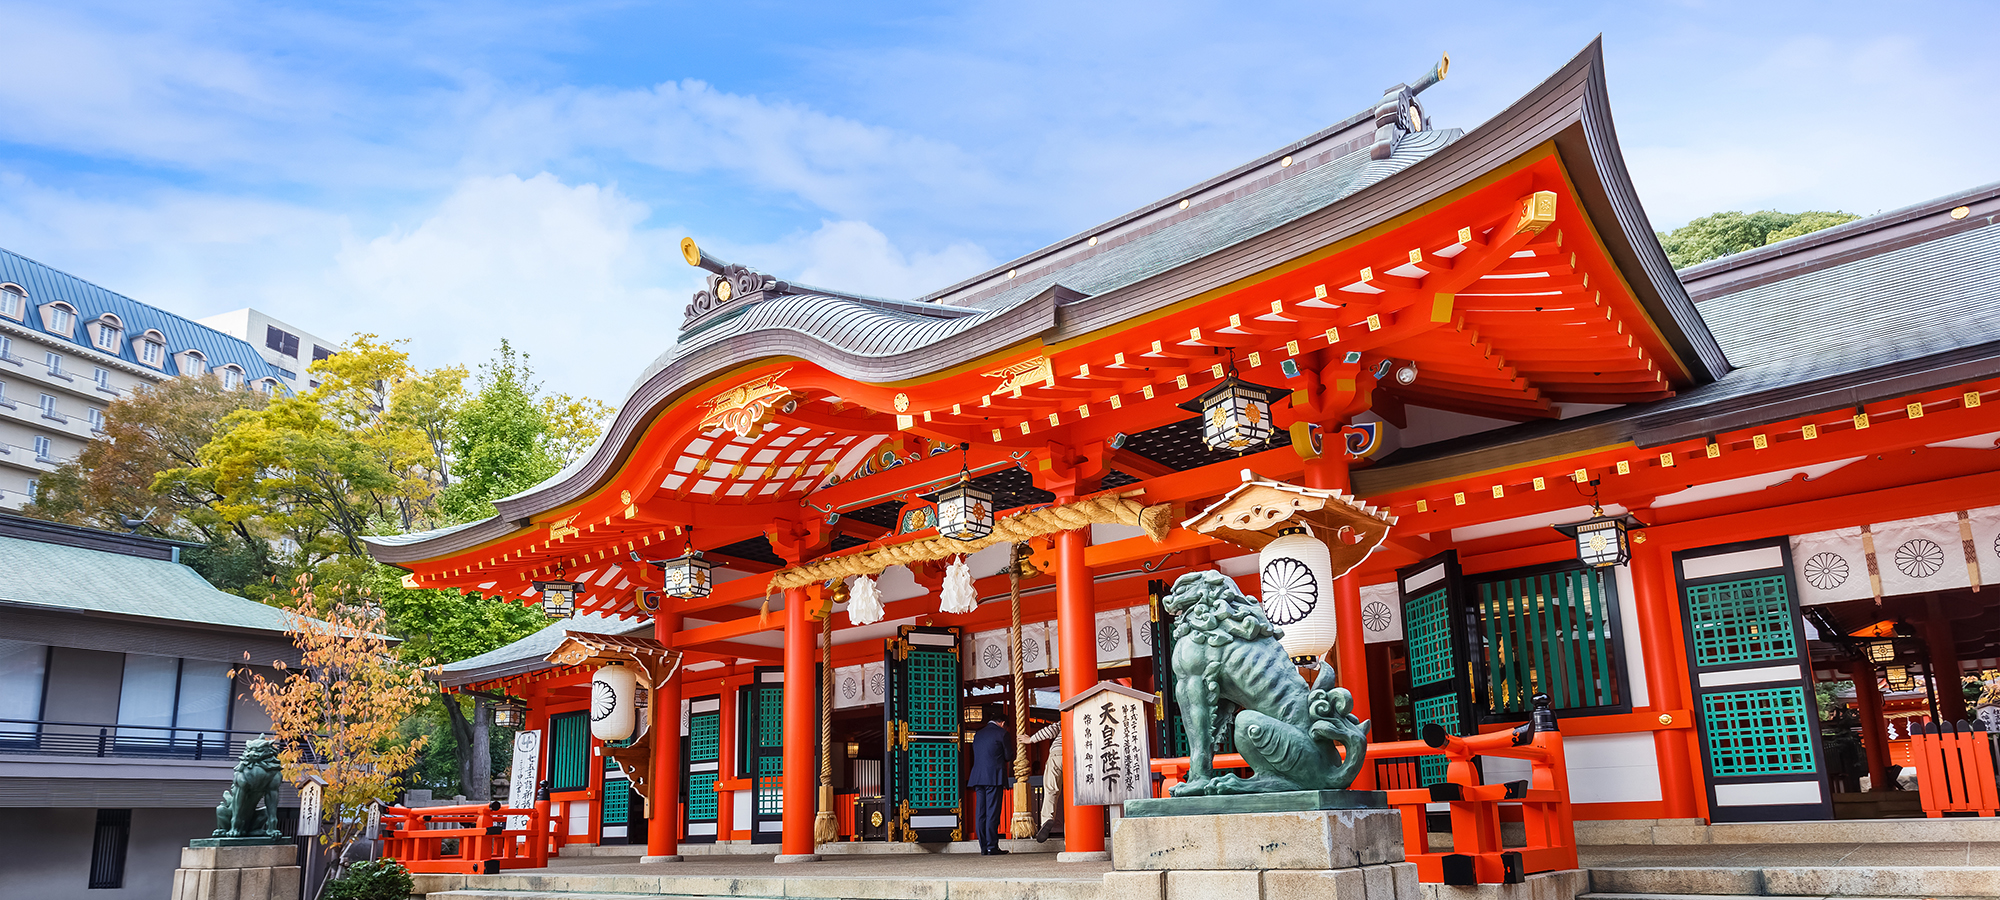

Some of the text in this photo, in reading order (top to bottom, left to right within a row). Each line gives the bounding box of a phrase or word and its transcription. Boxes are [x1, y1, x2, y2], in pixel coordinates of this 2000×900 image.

[1082, 714, 1095, 785] 幣帛料御下賜
[1098, 702, 1121, 793] 天皇陛下
[1129, 703, 1140, 781] 平成二十一年九月二十日
